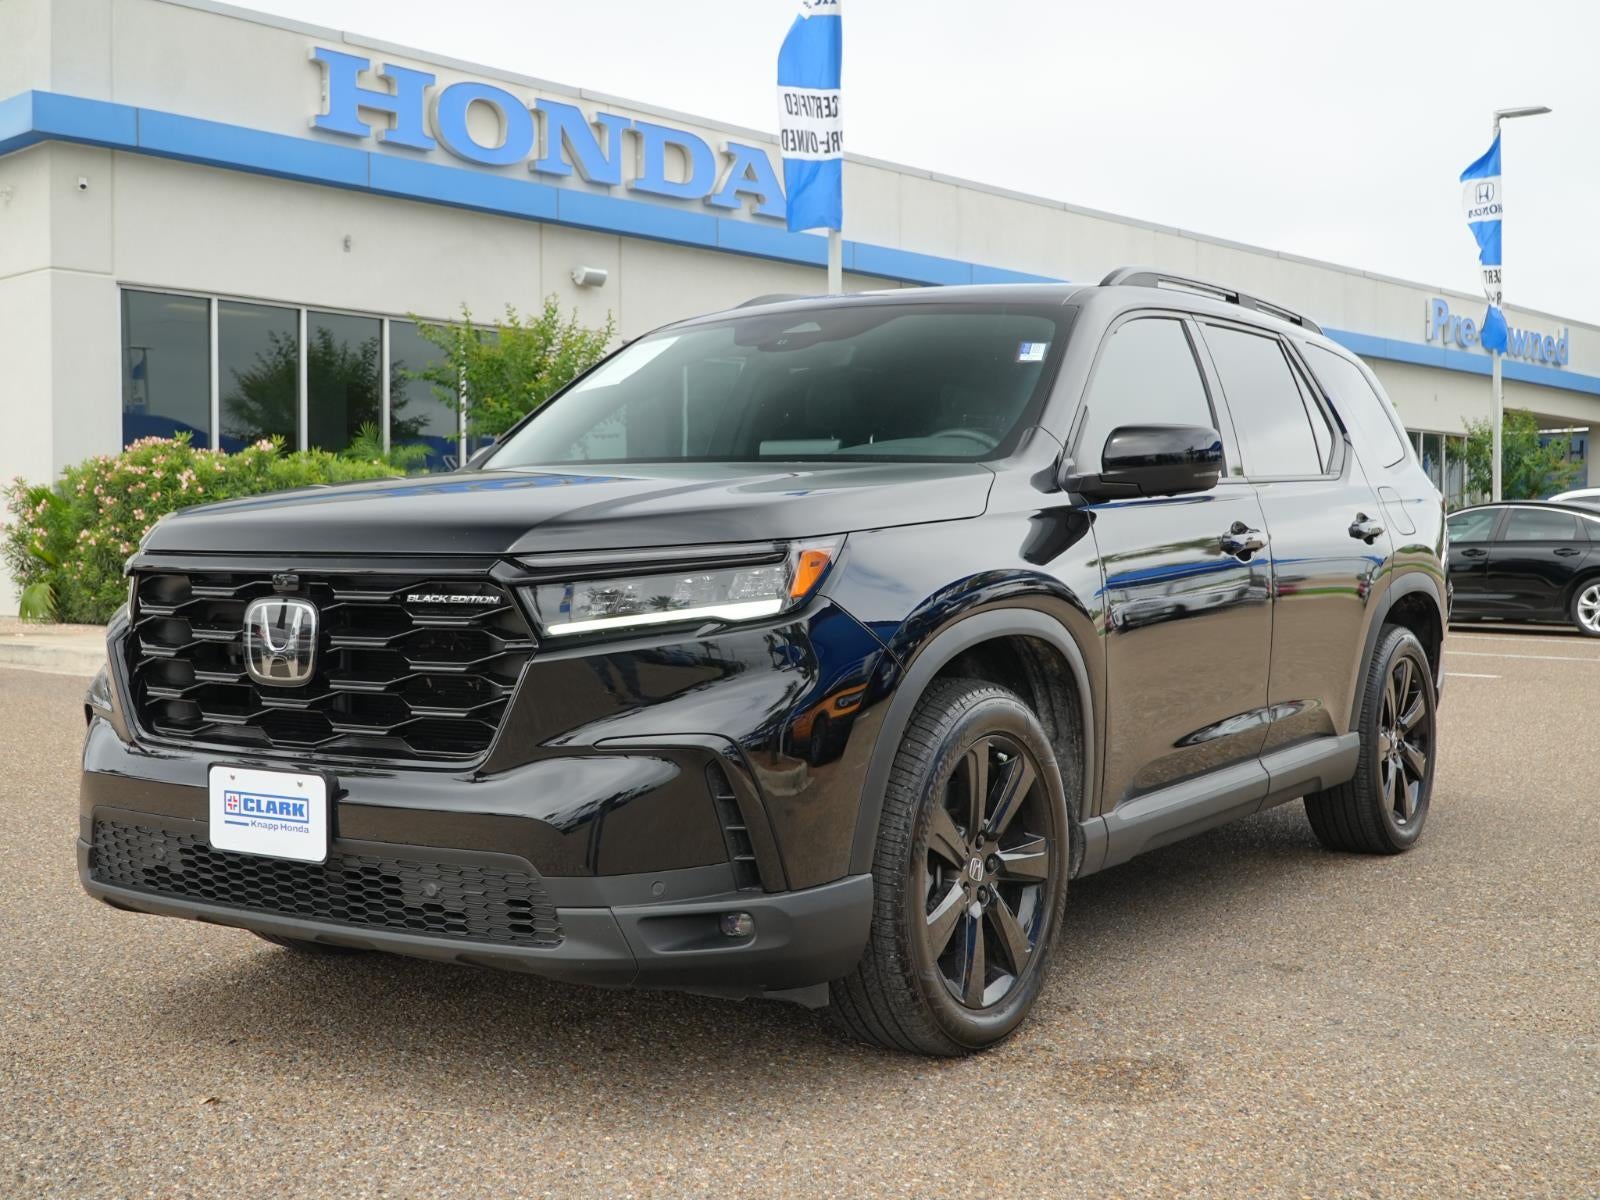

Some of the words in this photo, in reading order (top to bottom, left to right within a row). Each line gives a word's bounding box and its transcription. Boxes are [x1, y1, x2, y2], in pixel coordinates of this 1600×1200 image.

[308, 46, 787, 219] HONDA
[1425, 297, 1569, 367] Prewned
[407, 594, 448, 603] BLACK
[450, 595, 500, 604] EDITION
[243, 797, 305, 817] CLARK
[250, 820, 279, 831] Knapp
[280, 823, 310, 833] Honda
